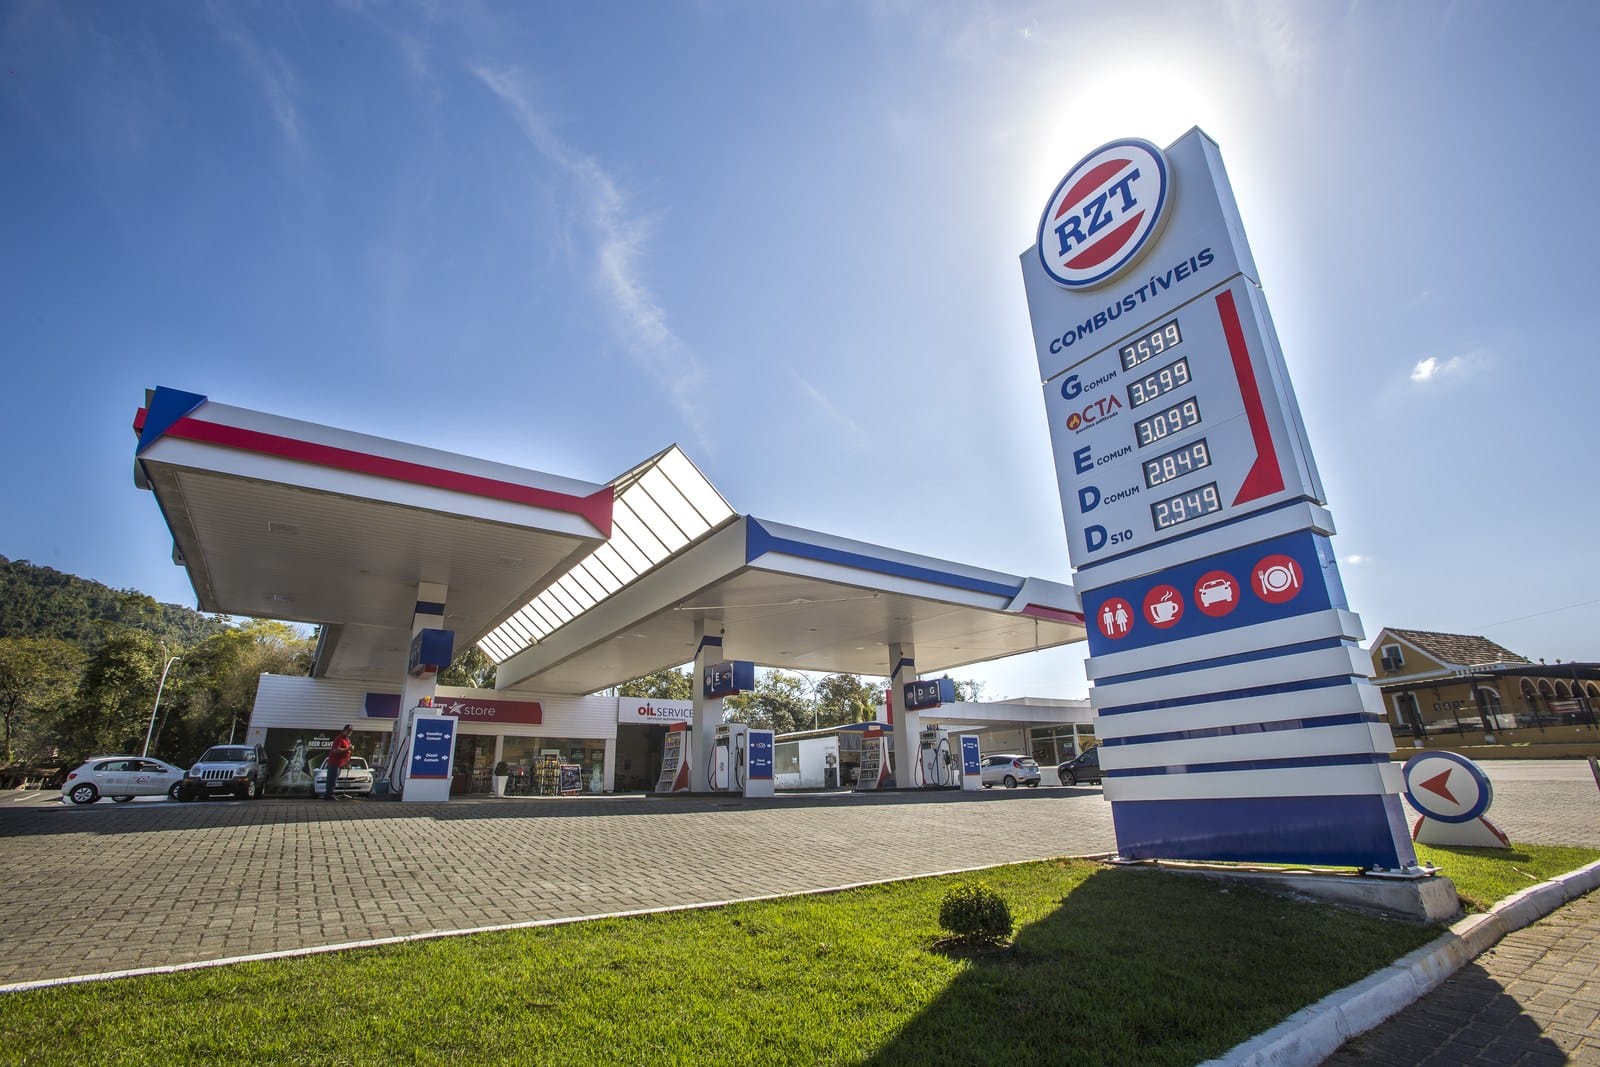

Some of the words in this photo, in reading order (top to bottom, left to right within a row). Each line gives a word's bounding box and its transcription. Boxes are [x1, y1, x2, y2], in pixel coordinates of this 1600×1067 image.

[1054, 168, 1141, 257] RZT
[1049, 248, 1215, 354] COMBUSTÍVEIS
[1124, 325, 1179, 369] 3.599
[1061, 374, 1082, 400] G
[1083, 370, 1117, 393] COMUM
[1132, 362, 1188, 405] 3.599
[1066, 394, 1122, 431] OCTA
[1140, 402, 1198, 444] 3.099
[1073, 444, 1094, 475] E
[1096, 445, 1132, 466] COMUM
[1149, 444, 1208, 485] 2.849
[1078, 486, 1101, 514] D
[1103, 485, 1140, 505] COMUM
[1157, 487, 1219, 527] 2.949
[1083, 524, 1108, 553] D
[1110, 529, 1133, 545] S10
[464, 706, 496, 716] store
